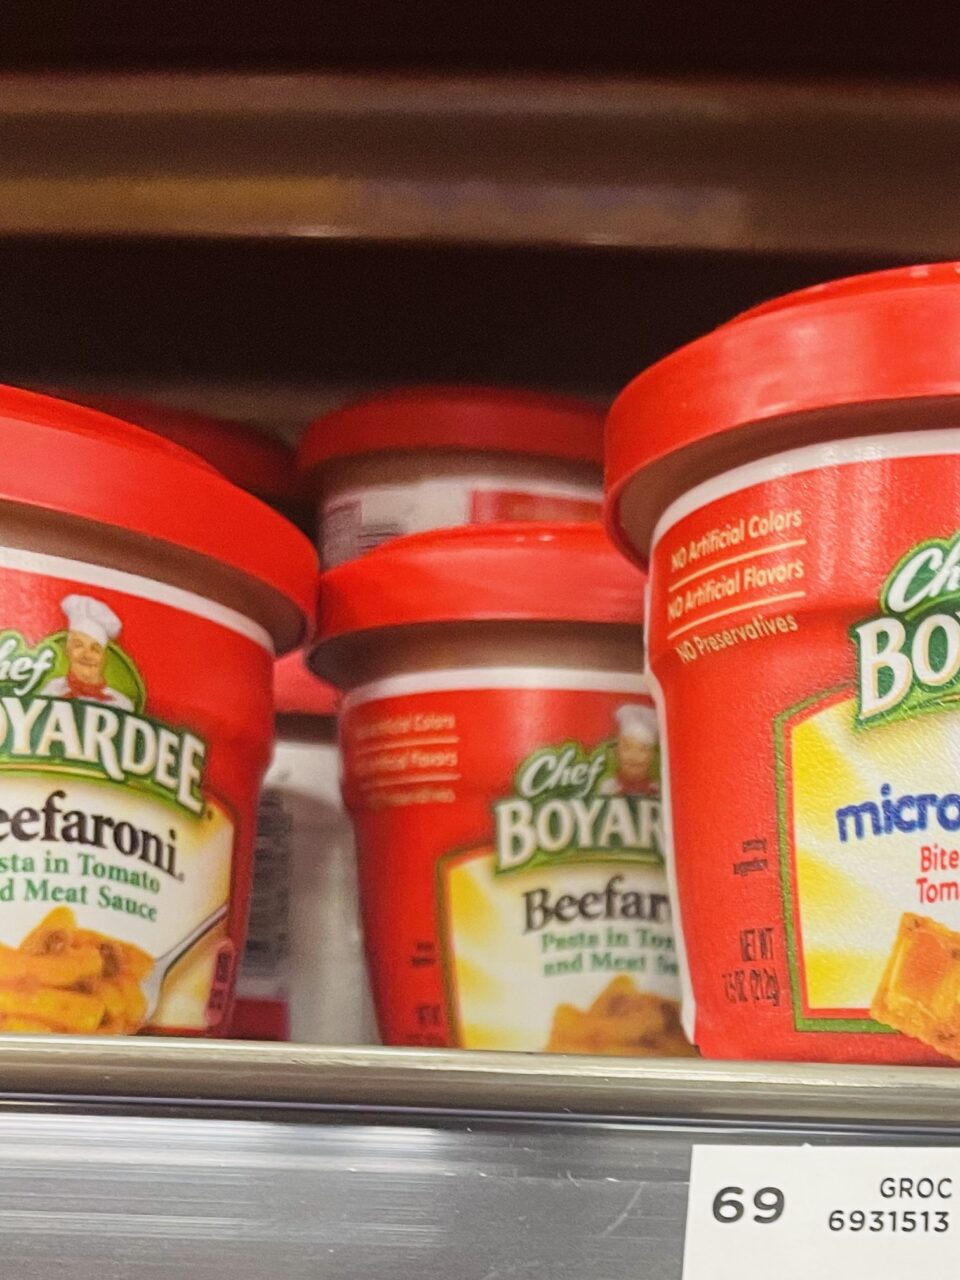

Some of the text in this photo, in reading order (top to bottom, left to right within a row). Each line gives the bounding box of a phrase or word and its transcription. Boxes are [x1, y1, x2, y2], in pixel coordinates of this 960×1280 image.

[689, 519, 744, 562] Artificial
[749, 510, 803, 538] Colors
[685, 570, 740, 612] Artificial
[744, 560, 804, 591] Flavors
[694, 612, 798, 655] Preservatives
[521, 749, 605, 798] Chef
[44, 850, 69, 874] in
[77, 852, 160, 893] Tomato
[920, 842, 959, 872] Bite
[24, 879, 87, 905] Meat
[98, 886, 158, 922] Sauce
[712, 1187, 785, 1224] 69
[880, 1178, 953, 1199] GROC
[828, 1210, 950, 1232] 6931513
